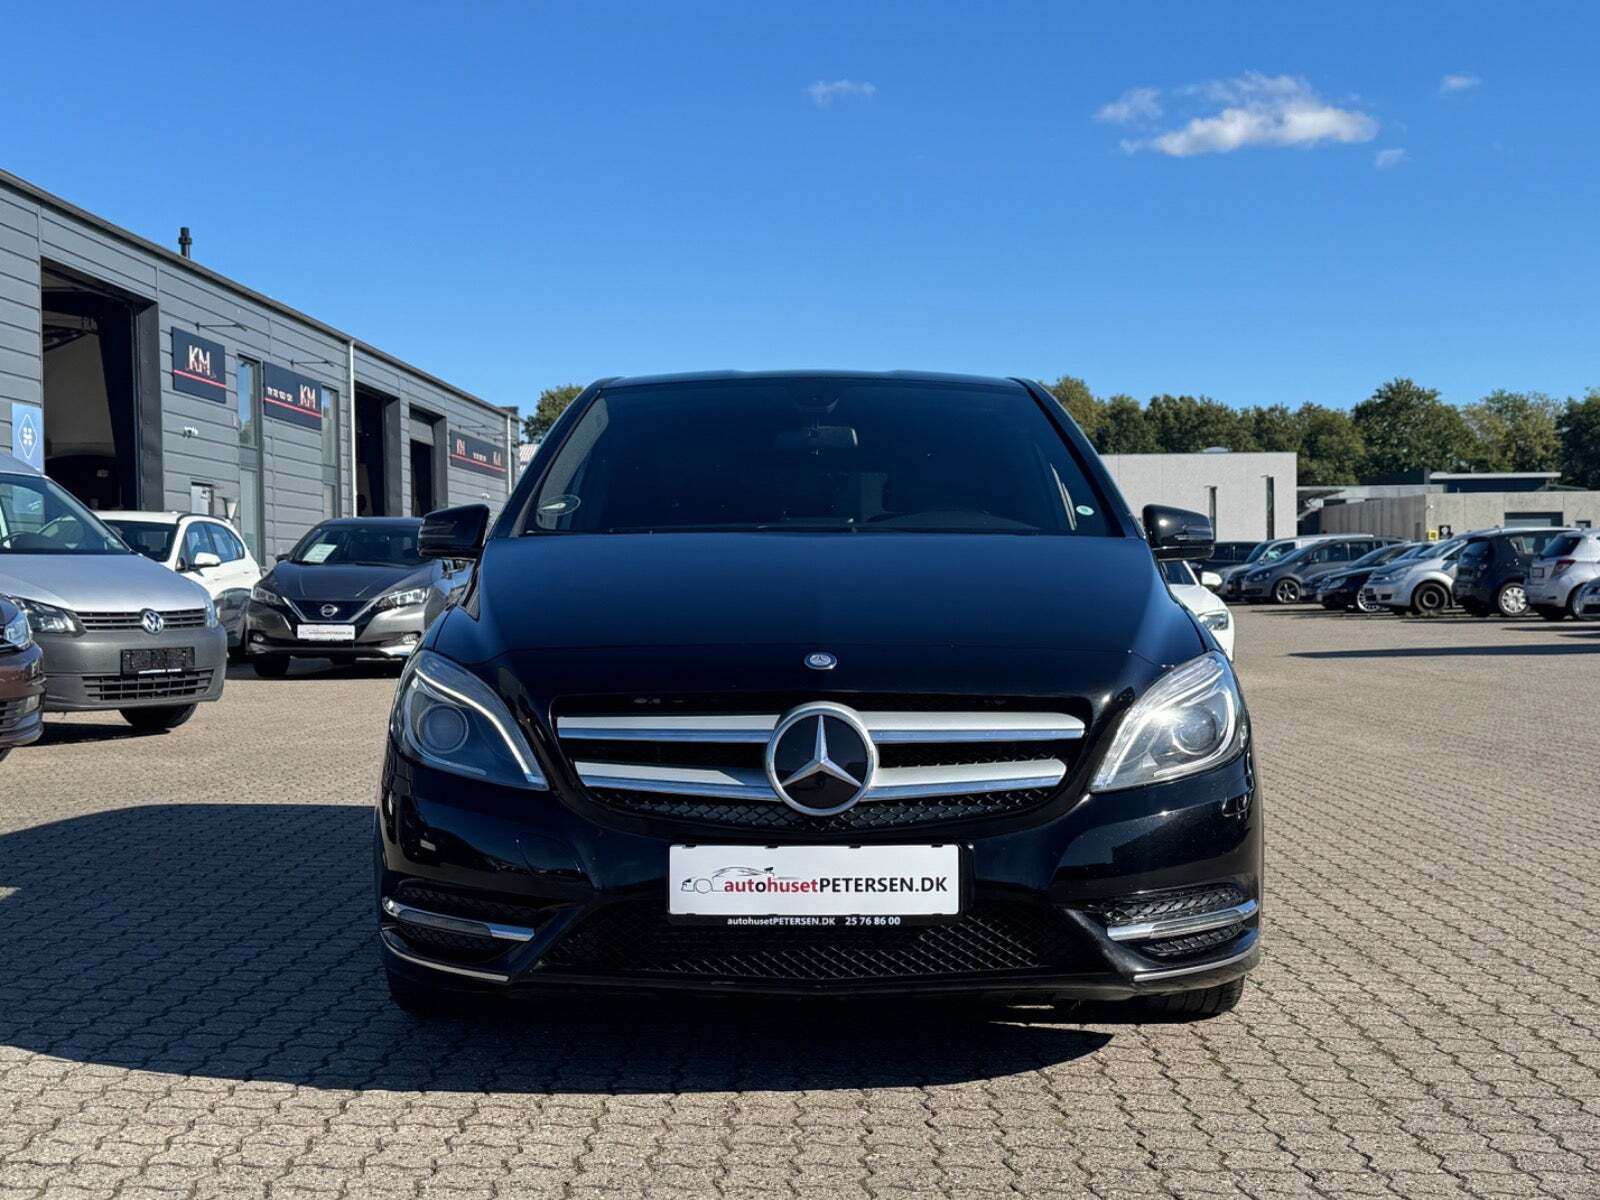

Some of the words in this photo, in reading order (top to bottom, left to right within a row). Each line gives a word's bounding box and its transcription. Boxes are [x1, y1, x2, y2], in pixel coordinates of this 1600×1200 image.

[189, 345, 210, 376] KM
[300, 384, 316, 409] KM
[724, 877, 948, 893] autohusetPETERSEN.DK
[727, 916, 836, 926] autohusetPETERSEN.DK
[845, 917, 858, 926] 25
[859, 917, 873, 926] 76
[888, 917, 901, 926] 00
